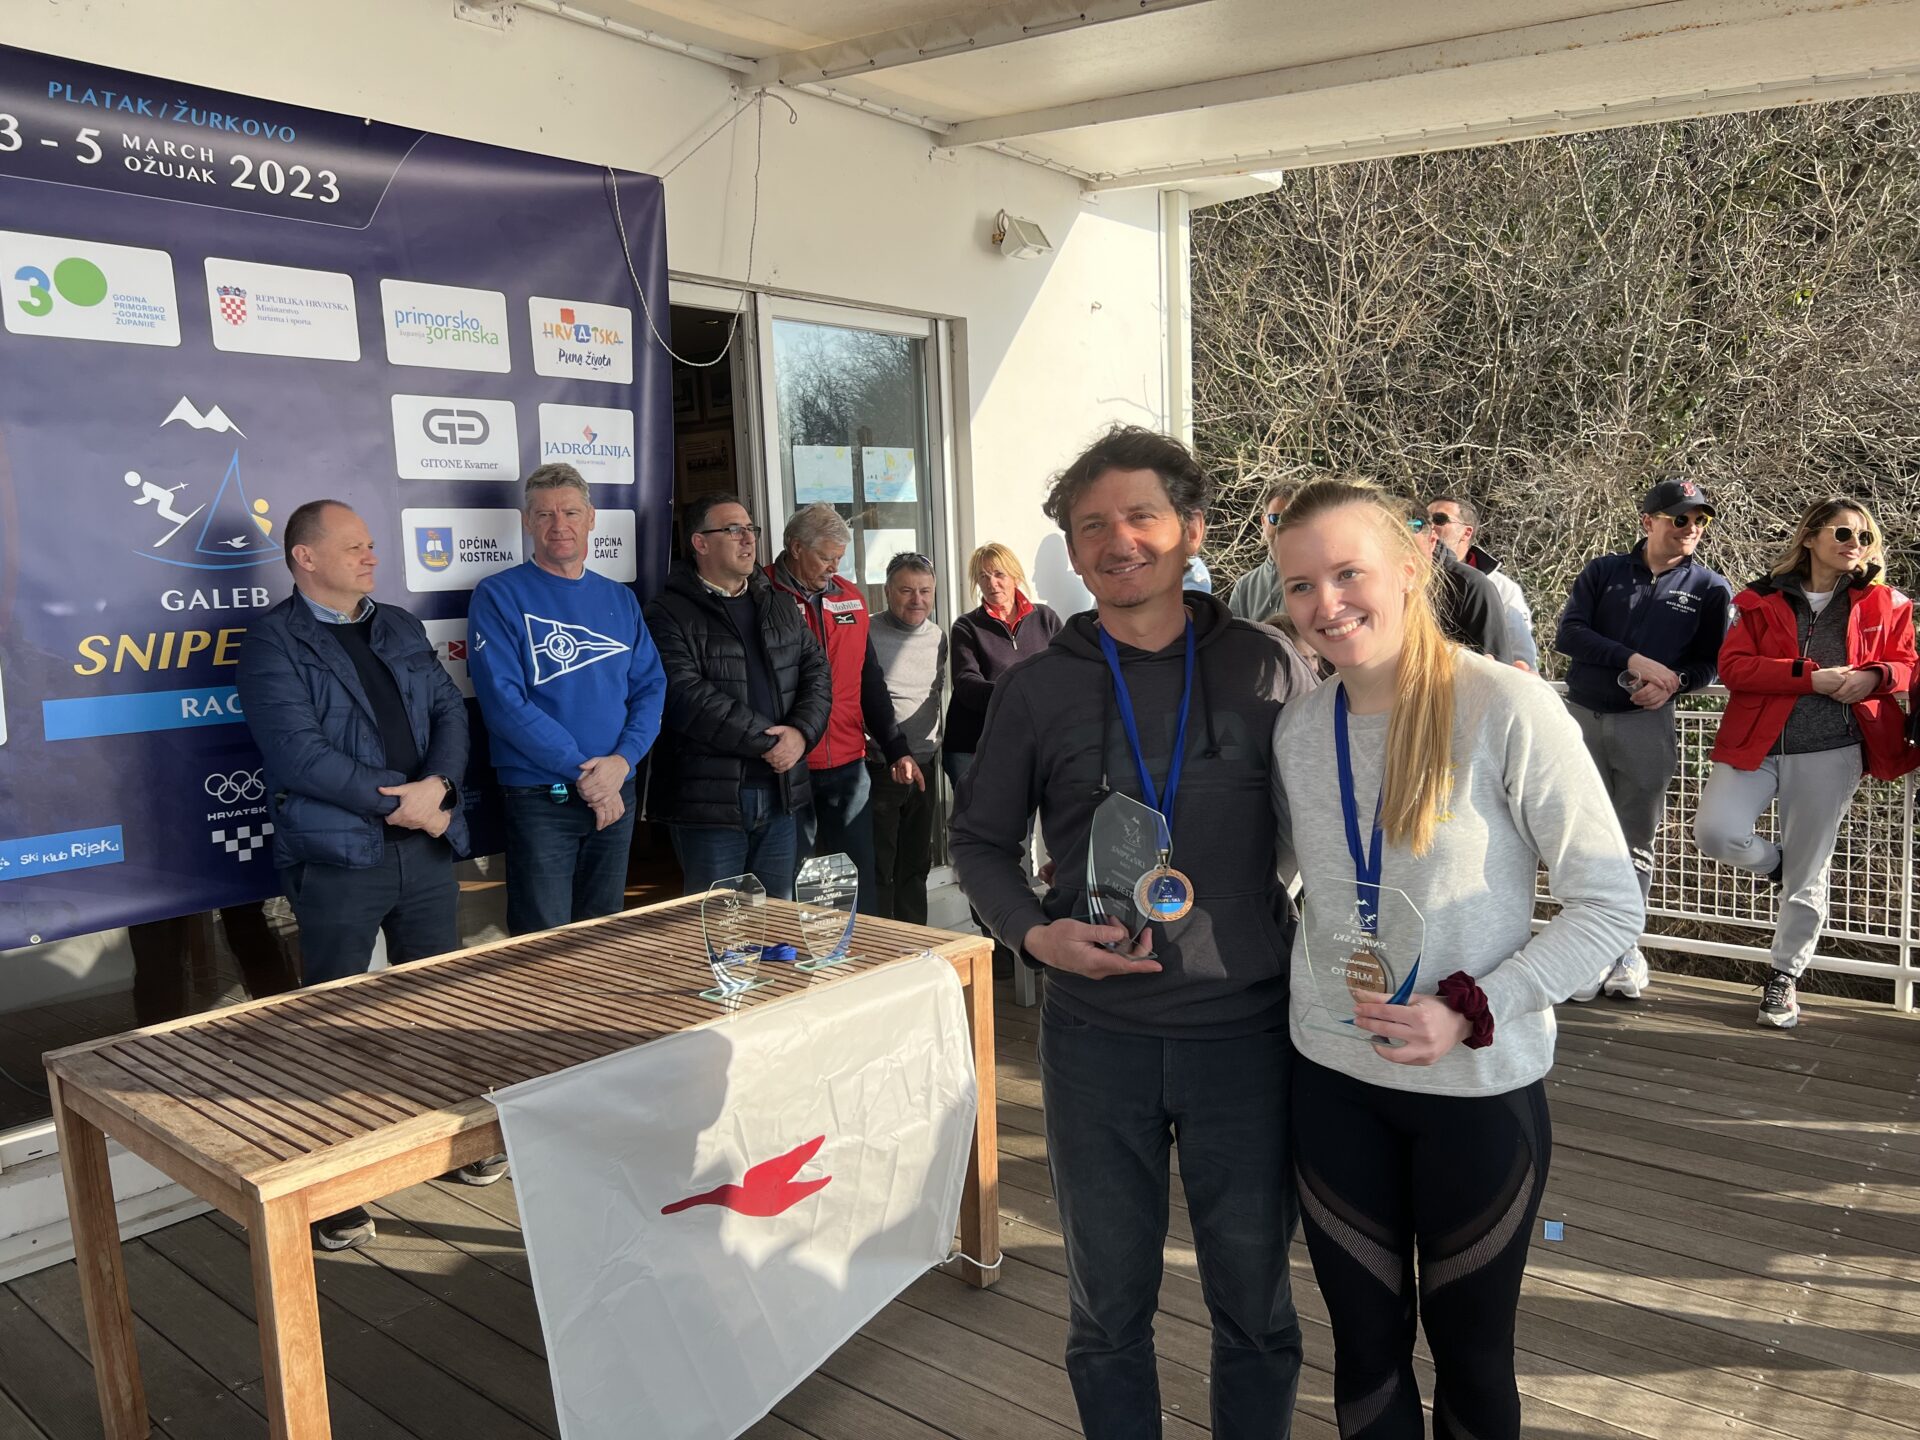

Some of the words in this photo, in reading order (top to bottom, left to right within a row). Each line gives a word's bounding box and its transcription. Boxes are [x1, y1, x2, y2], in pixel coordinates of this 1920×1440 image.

[0, 113, 23, 152] 3
[75, 127, 103, 164] 5
[122, 133, 214, 164] MARCH
[124, 154, 217, 185] OŽUJAK
[229, 154, 340, 203] 2023
[113, 294, 147, 303] GODINA
[114, 302, 165, 313] PRIMORSKO
[256, 294, 304, 307] REPUBLIKA
[305, 299, 349, 312] HRVATSKA
[256, 303, 300, 315] Ministarstvo
[395, 306, 480, 331] primorsko
[426, 325, 499, 345] goranska
[542, 322, 624, 345] HRVATSKA
[558, 348, 583, 365] Puna
[544, 441, 631, 460] JADROLINIJA
[420, 458, 463, 469] GITONE
[464, 459, 499, 470] Kvarner
[460, 551, 514, 562] KOSTRENA
[161, 587, 270, 611] GALEB
[74, 628, 247, 675] SNIPE
[181, 693, 243, 719] RAC
[207, 806, 267, 821] HRVATSK
